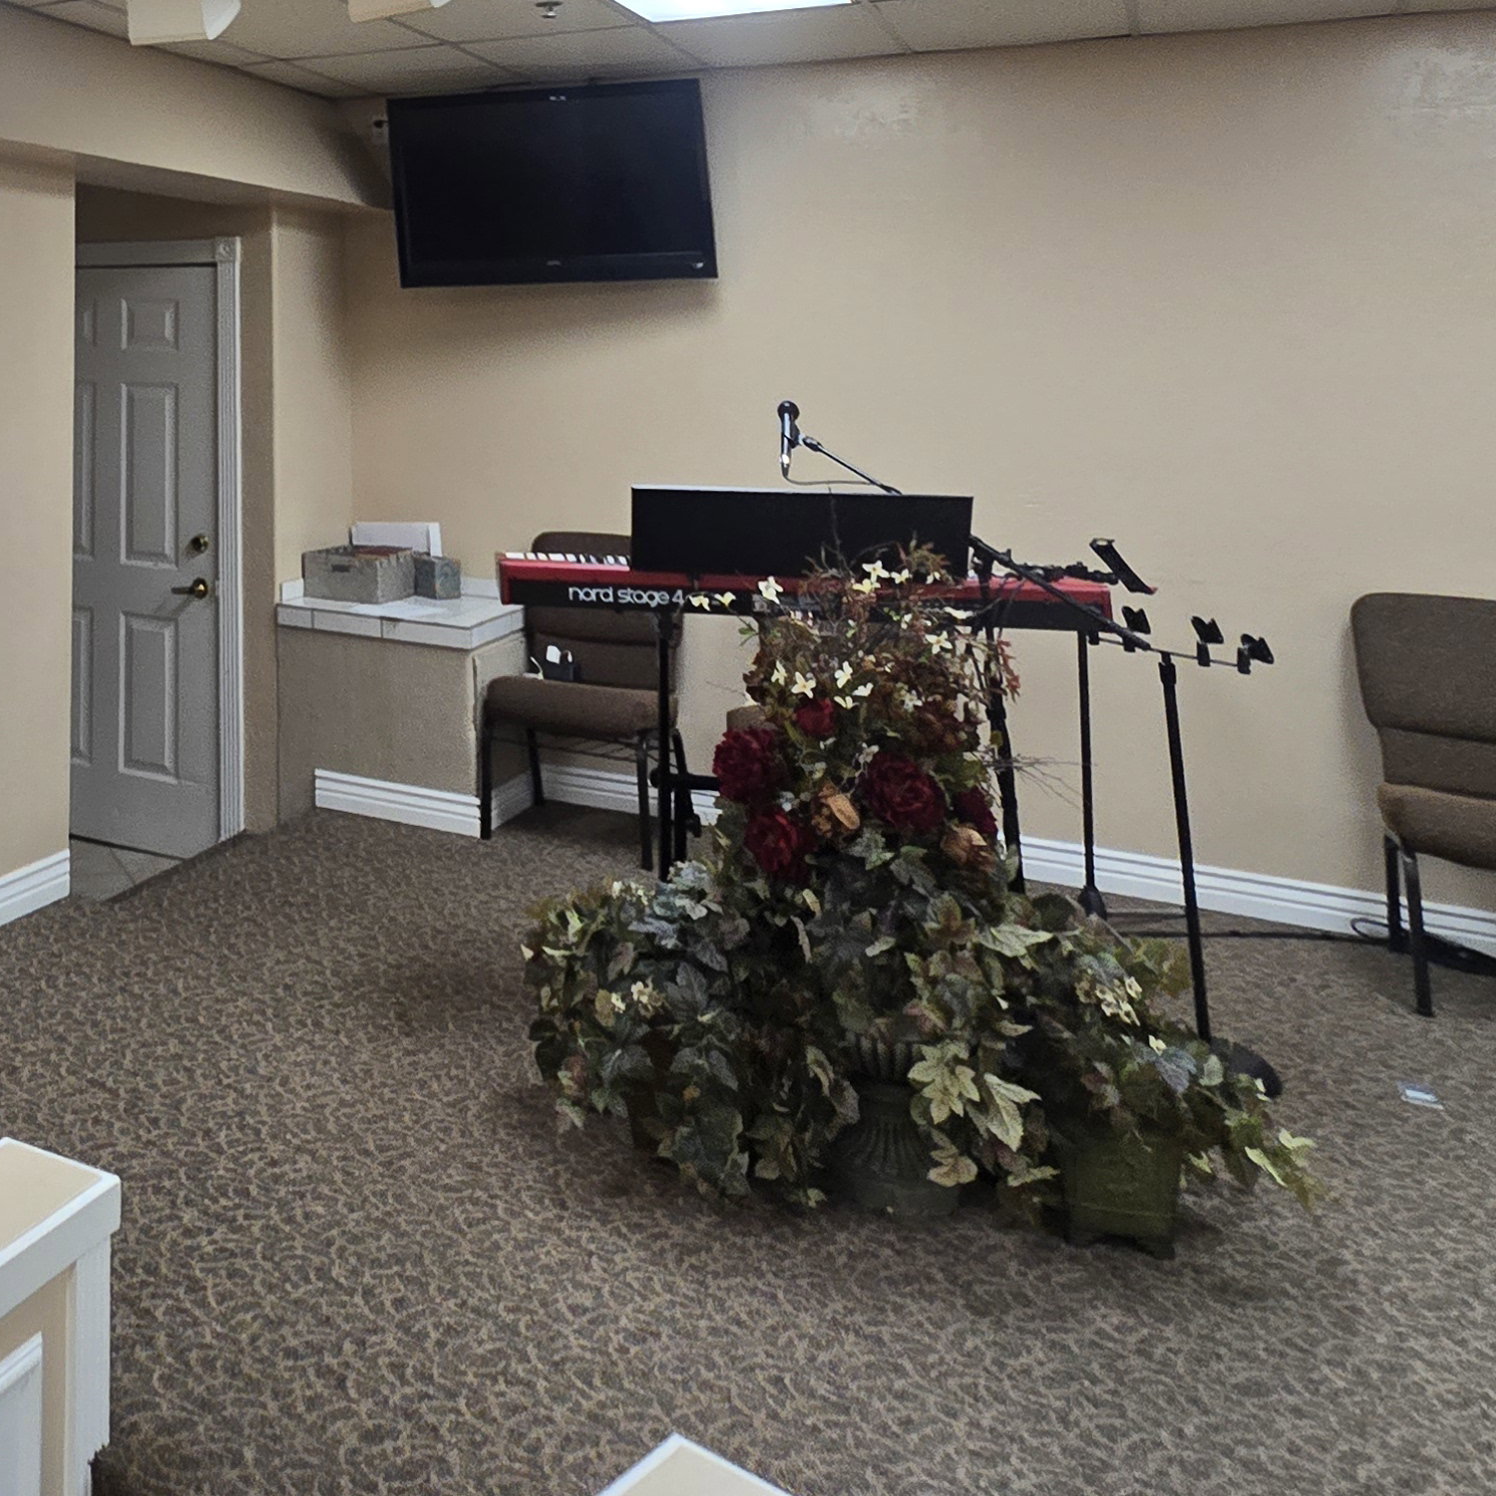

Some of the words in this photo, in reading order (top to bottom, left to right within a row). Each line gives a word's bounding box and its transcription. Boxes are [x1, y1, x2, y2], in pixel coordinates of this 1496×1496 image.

[568, 586, 614, 603] nord
[617, 588, 670, 608] stage
[672, 589, 685, 606] 4
